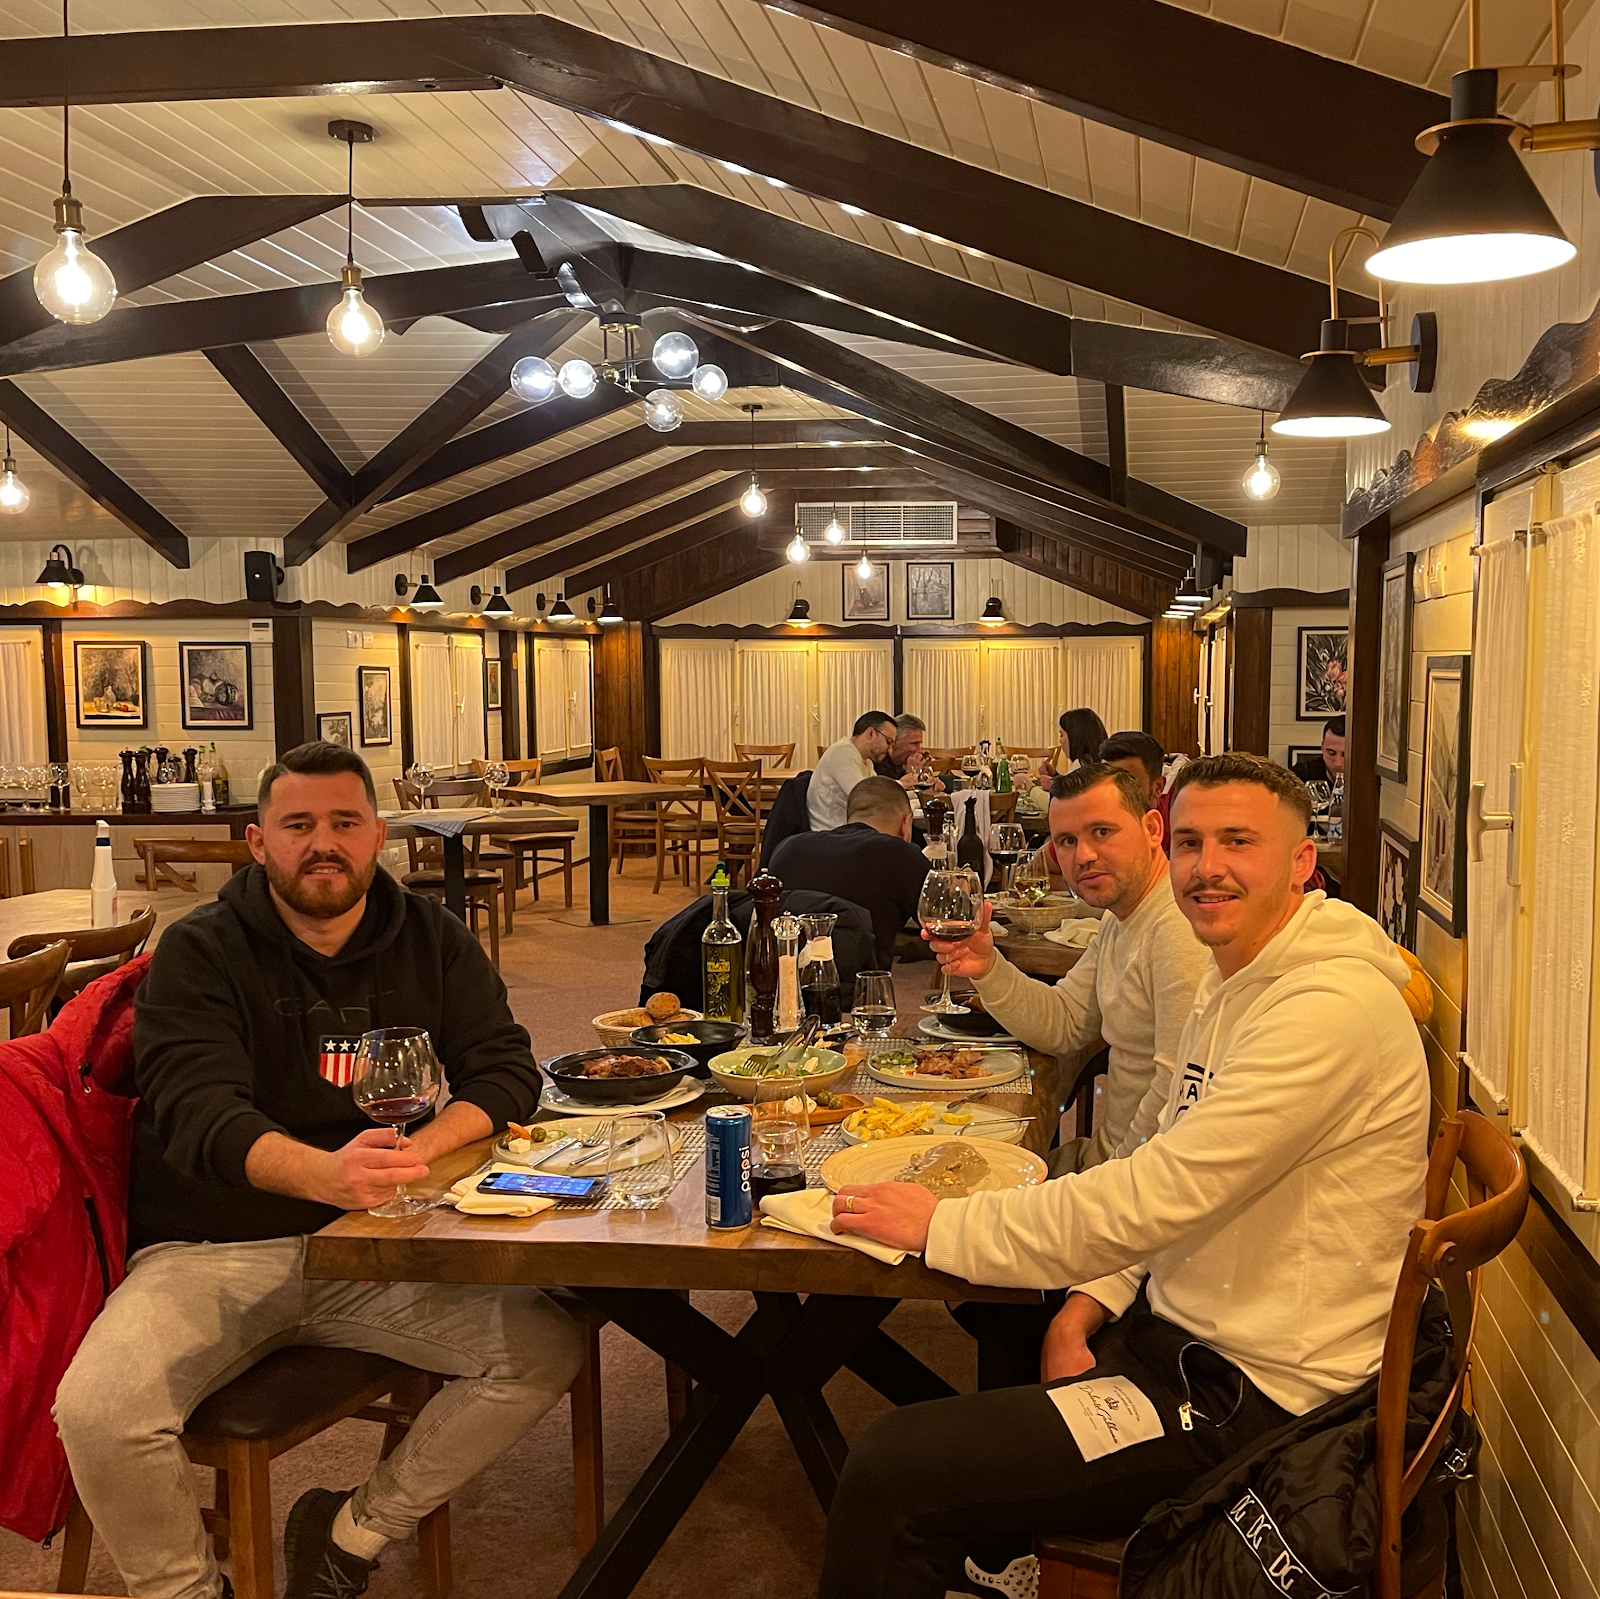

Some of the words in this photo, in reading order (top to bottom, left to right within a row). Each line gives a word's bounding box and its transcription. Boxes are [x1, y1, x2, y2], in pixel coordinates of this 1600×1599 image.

[739, 1145, 751, 1192] pepsi
[1246, 1514, 1272, 1550] DG
[1268, 1550, 1304, 1591] DG
